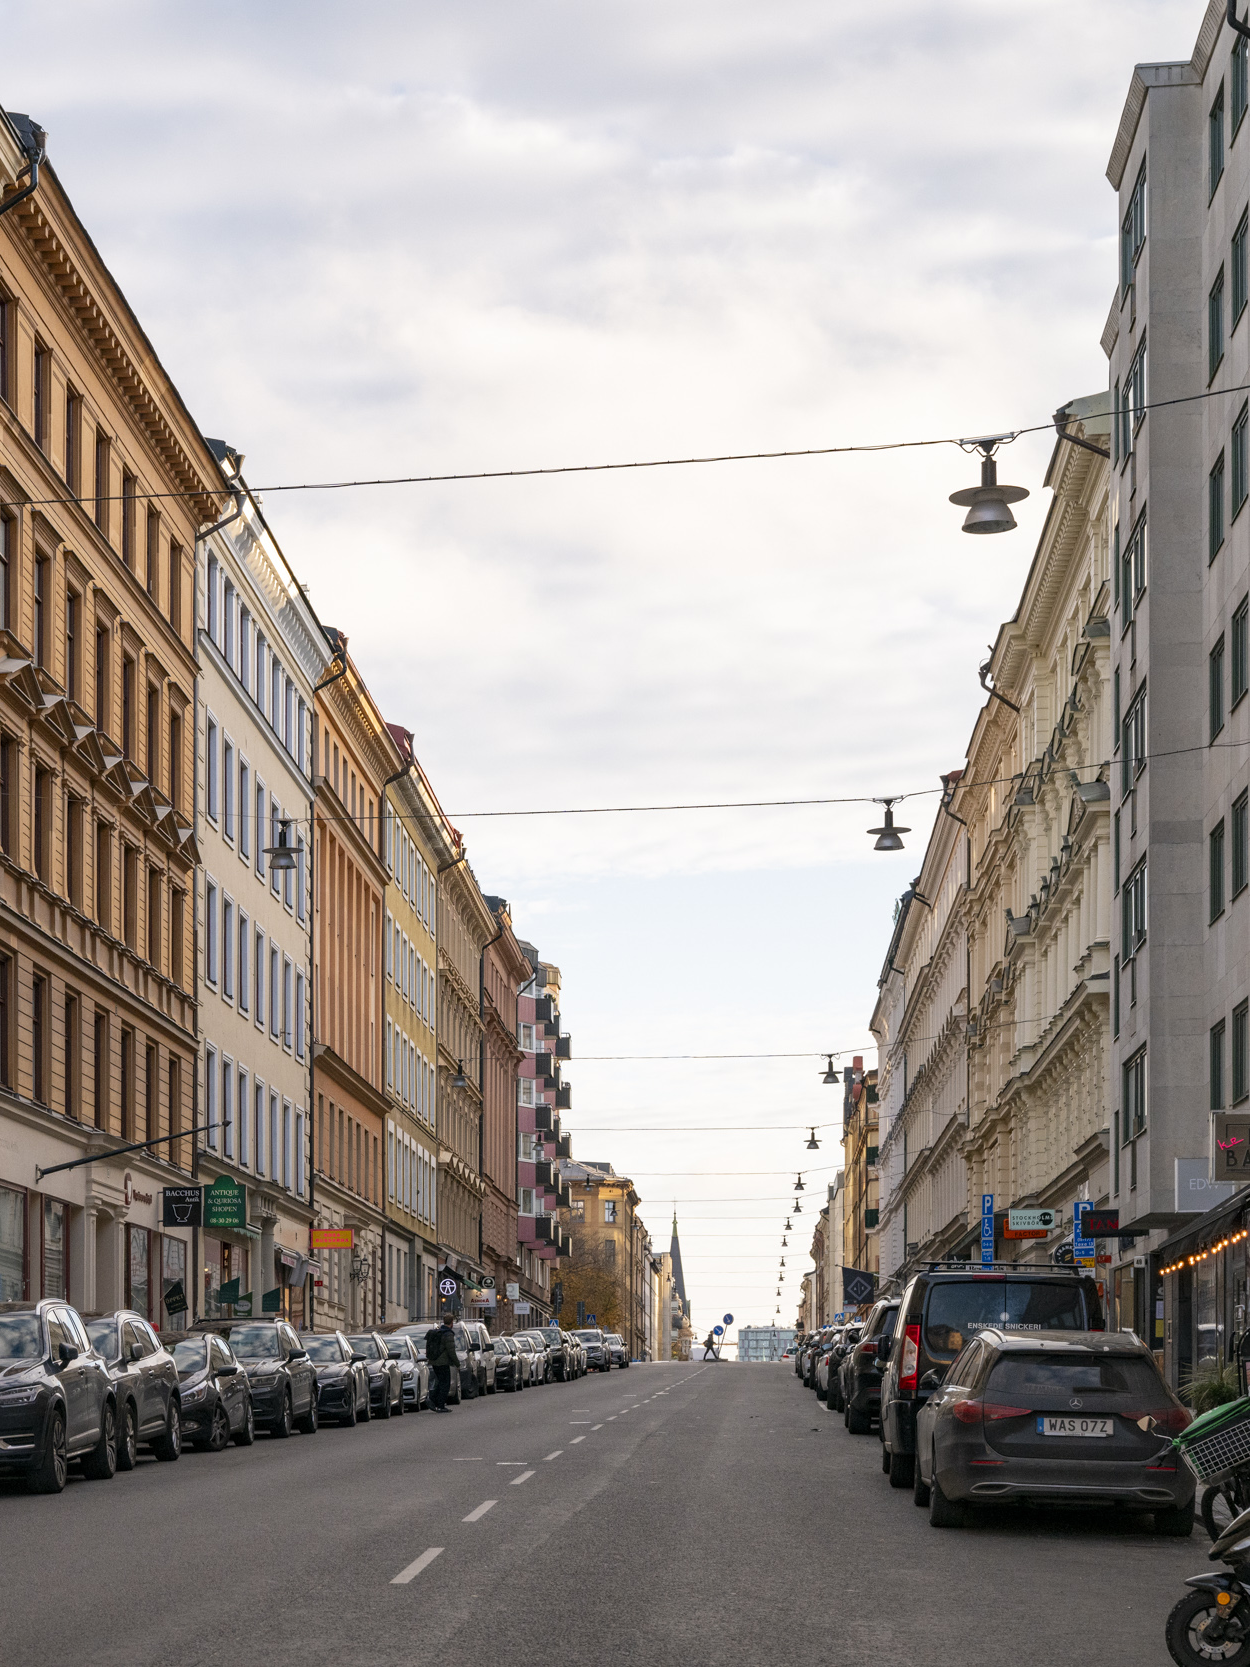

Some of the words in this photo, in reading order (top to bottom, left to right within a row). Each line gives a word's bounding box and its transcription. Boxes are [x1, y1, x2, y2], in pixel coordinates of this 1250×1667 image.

[210, 1189, 239, 1197] ANTIQUE
[984, 1196, 992, 1214] P
[1049, 1419, 1076, 1432] WAS
[1080, 1420, 1108, 1432] 07Z
